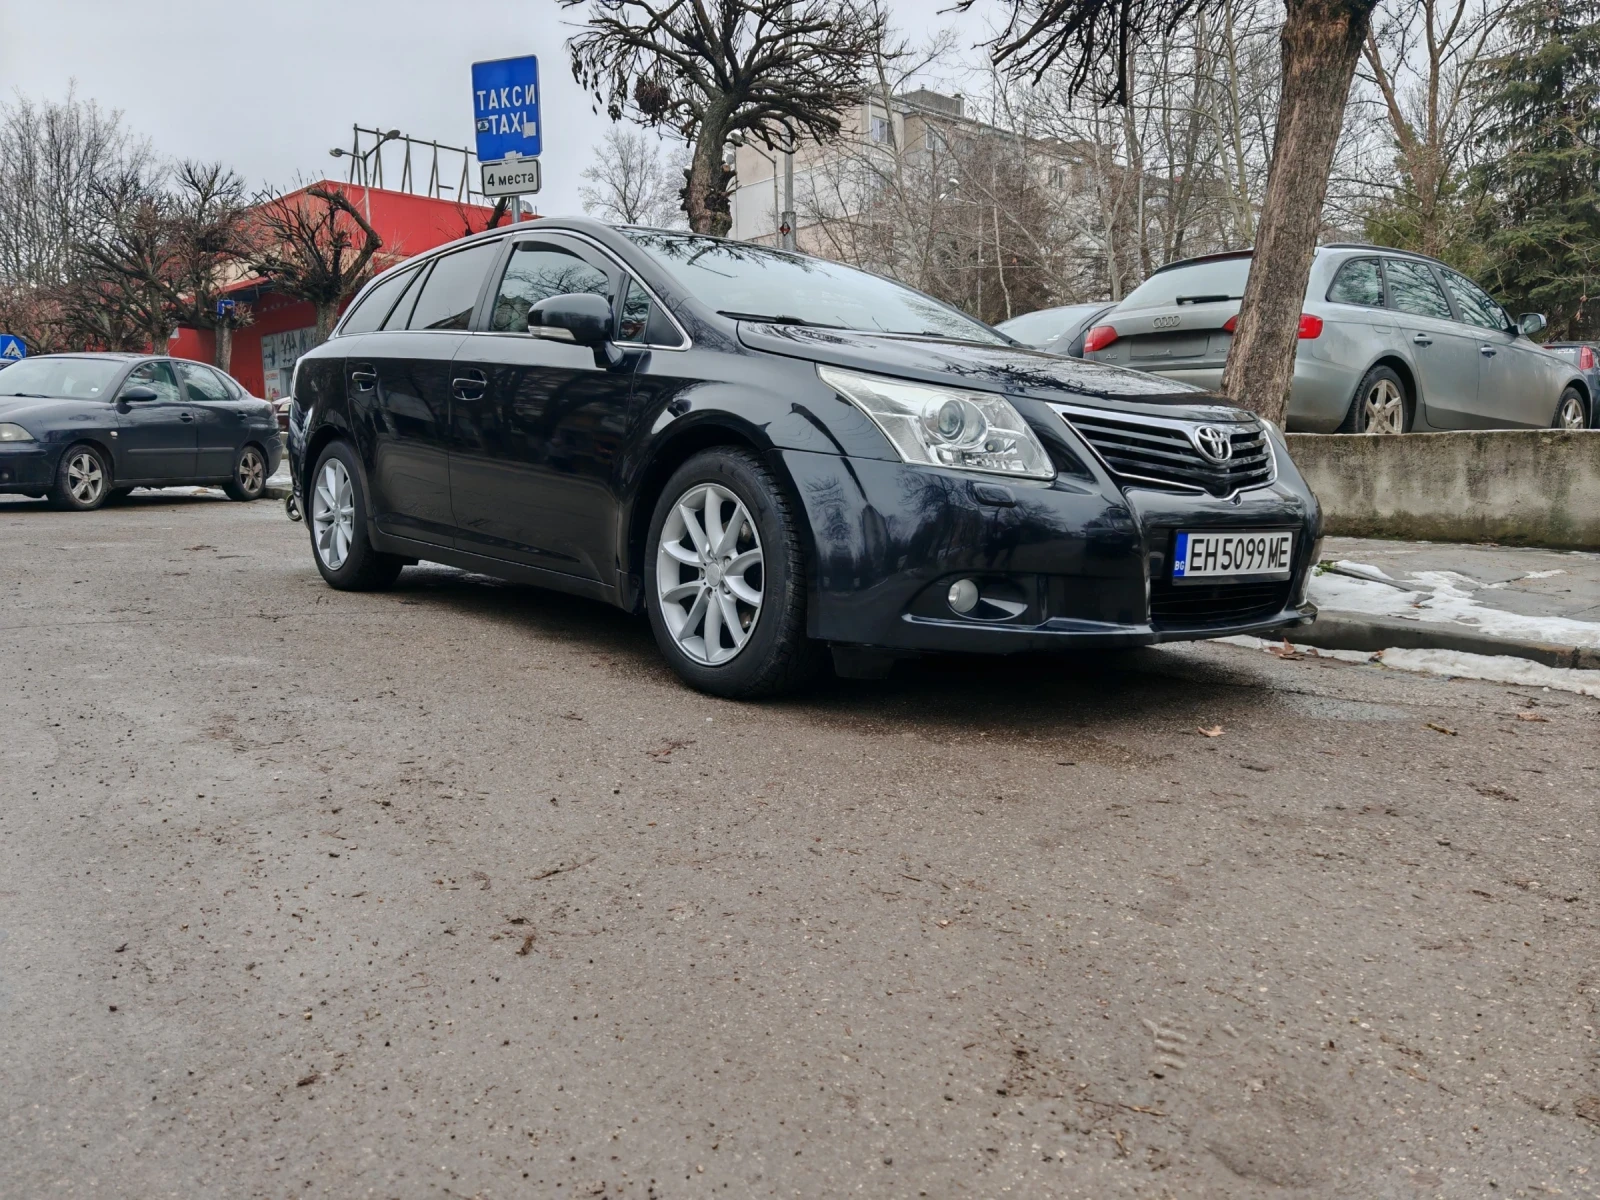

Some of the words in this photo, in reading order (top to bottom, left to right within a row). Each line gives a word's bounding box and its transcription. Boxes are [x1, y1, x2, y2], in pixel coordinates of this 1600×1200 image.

[477, 84, 535, 111] ТАКСИ
[489, 111, 527, 135] TAXI
[487, 173, 495, 187] 4
[499, 172, 534, 186] места
[1174, 560, 1185, 571] BG
[1189, 537, 1290, 571] EH5099ME
